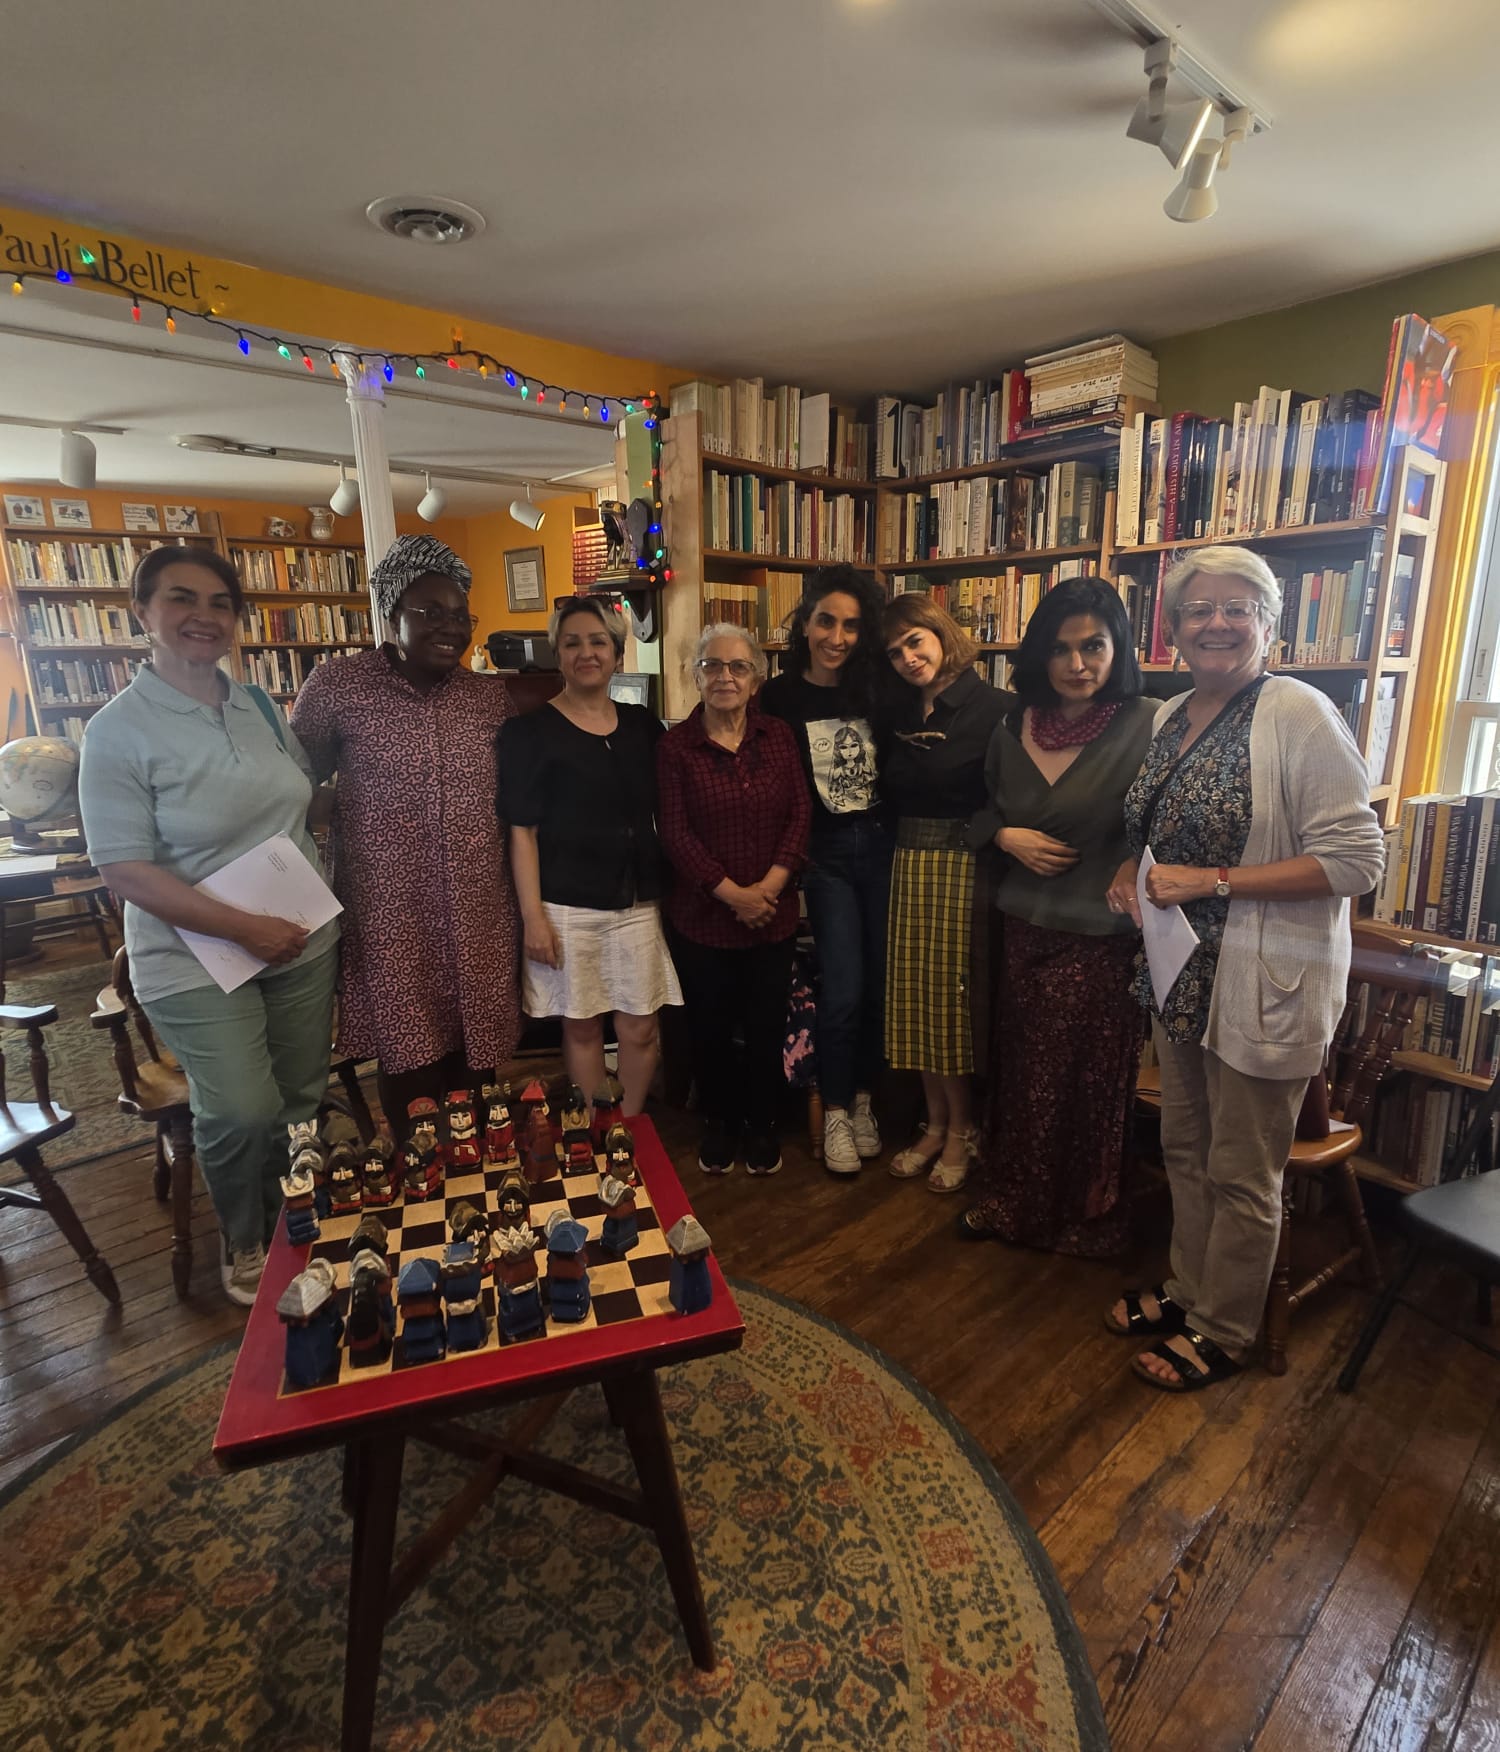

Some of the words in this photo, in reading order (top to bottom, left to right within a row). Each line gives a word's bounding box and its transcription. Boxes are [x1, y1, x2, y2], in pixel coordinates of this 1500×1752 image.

[0, 224, 73, 275] aulí
[98, 239, 201, 299] Bellet
[1170, 453, 1180, 496] HISTORY
[1454, 890, 1466, 921] SAGRADA
